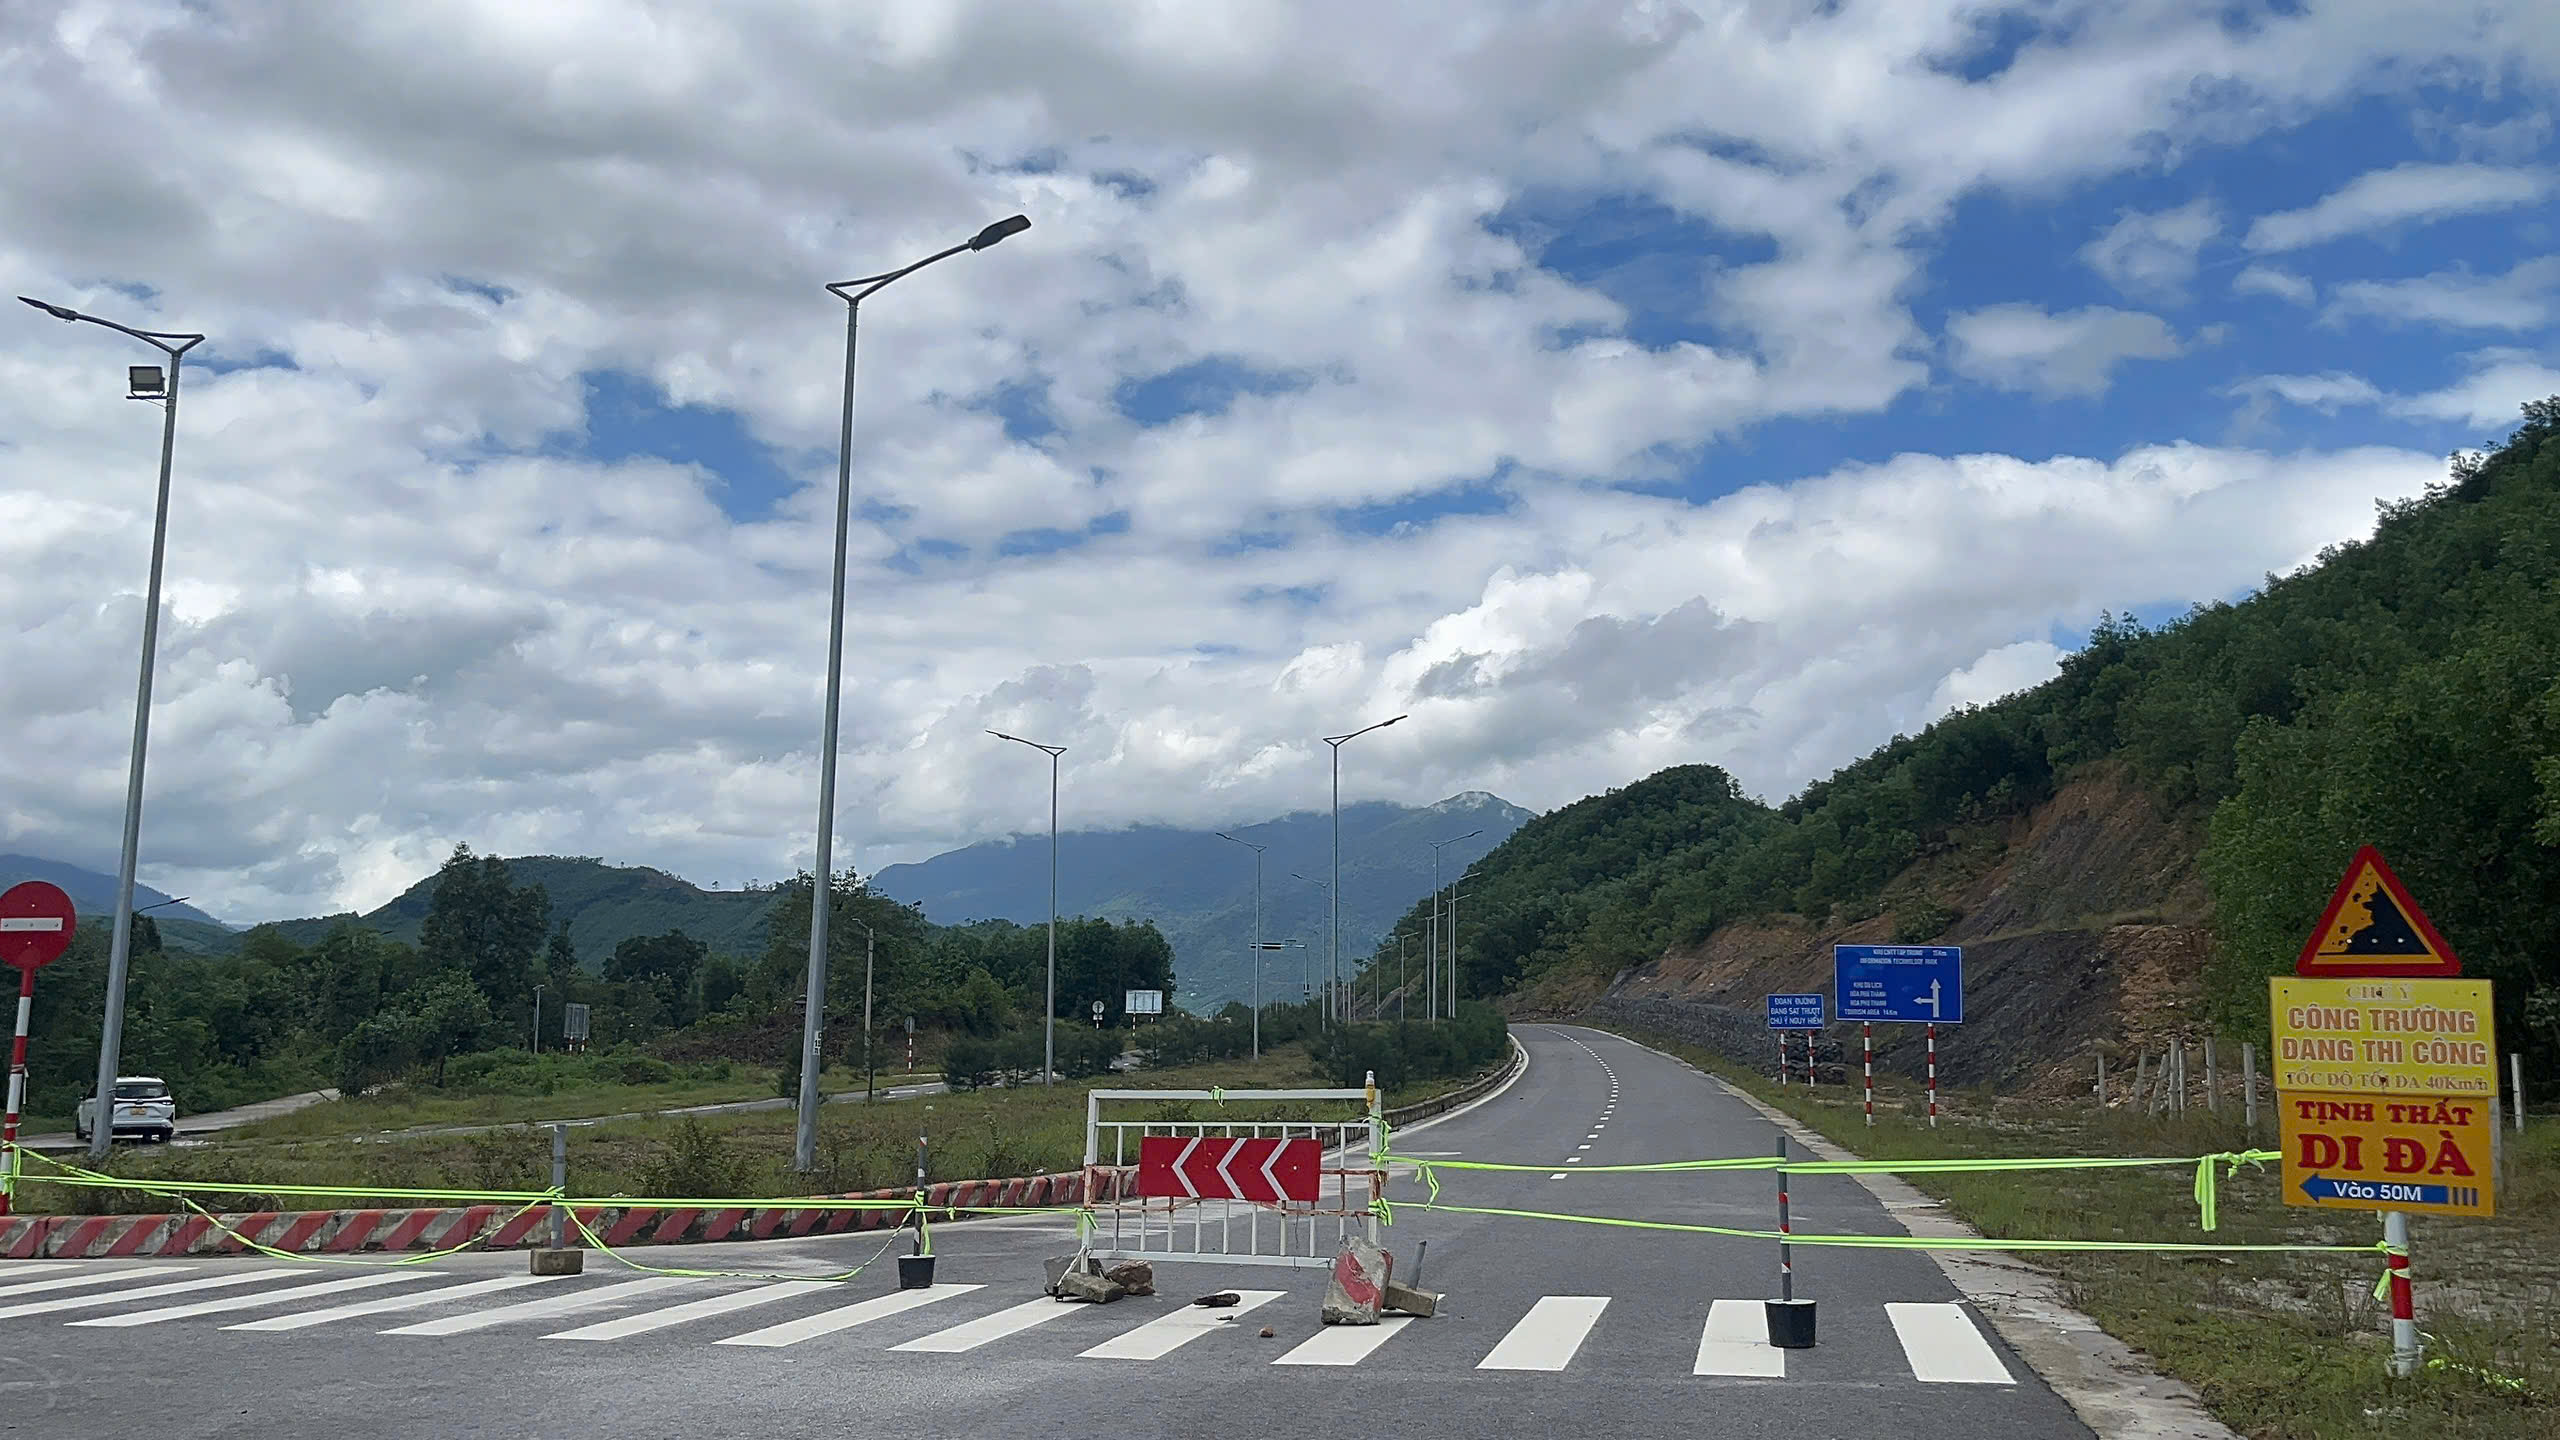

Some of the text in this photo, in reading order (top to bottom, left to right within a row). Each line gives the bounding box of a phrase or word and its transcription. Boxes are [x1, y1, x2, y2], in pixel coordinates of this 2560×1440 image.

[2287, 1003, 2476, 1033] CÔNG TRƯỜNG
[2281, 1037, 2488, 1065] ĐANG THI CÔNG
[2284, 1066, 2322, 1086] TỐC
[2327, 1070, 2353, 1089] ĐỘ
[2358, 1066, 2389, 1088] TỐI
[2395, 1074, 2421, 1089] ĐA
[2295, 1096, 2474, 1126] TỊNH THẤT
[2297, 1129, 2476, 1177] DI ĐÀ
[2333, 1181, 2422, 1202] Vào 50M
